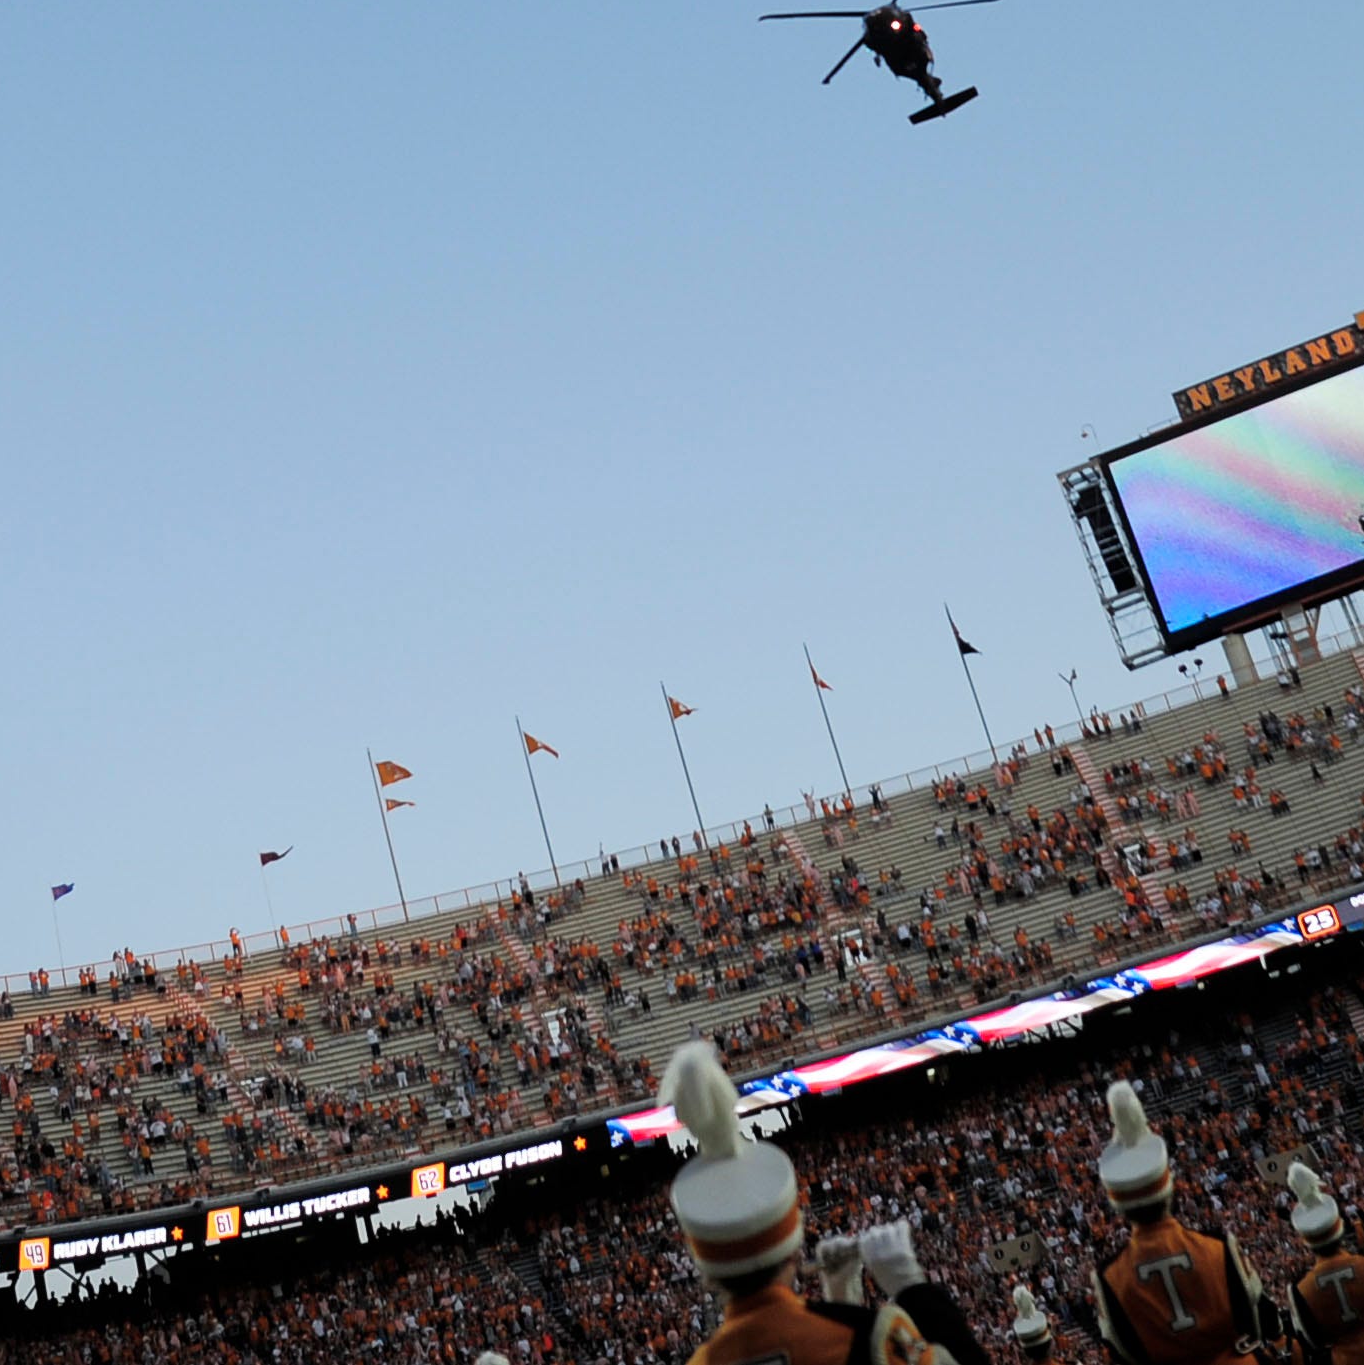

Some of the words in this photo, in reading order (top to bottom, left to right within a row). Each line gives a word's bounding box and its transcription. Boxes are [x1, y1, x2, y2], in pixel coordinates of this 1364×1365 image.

[1187, 328, 1356, 411] NEYLAND
[1304, 910, 1334, 934] 25
[418, 1167, 440, 1190] 62
[449, 1154, 503, 1182] CLYDE
[505, 1140, 563, 1169] FUSON
[214, 1212, 233, 1235] 61
[244, 1202, 301, 1227] WILLIS
[302, 1187, 370, 1215] TUCKER
[23, 1242, 46, 1265] 49
[53, 1238, 99, 1260] RUDY
[102, 1226, 167, 1253] KLARER
[1138, 1253, 1196, 1333] T
[1316, 1266, 1358, 1323] T
